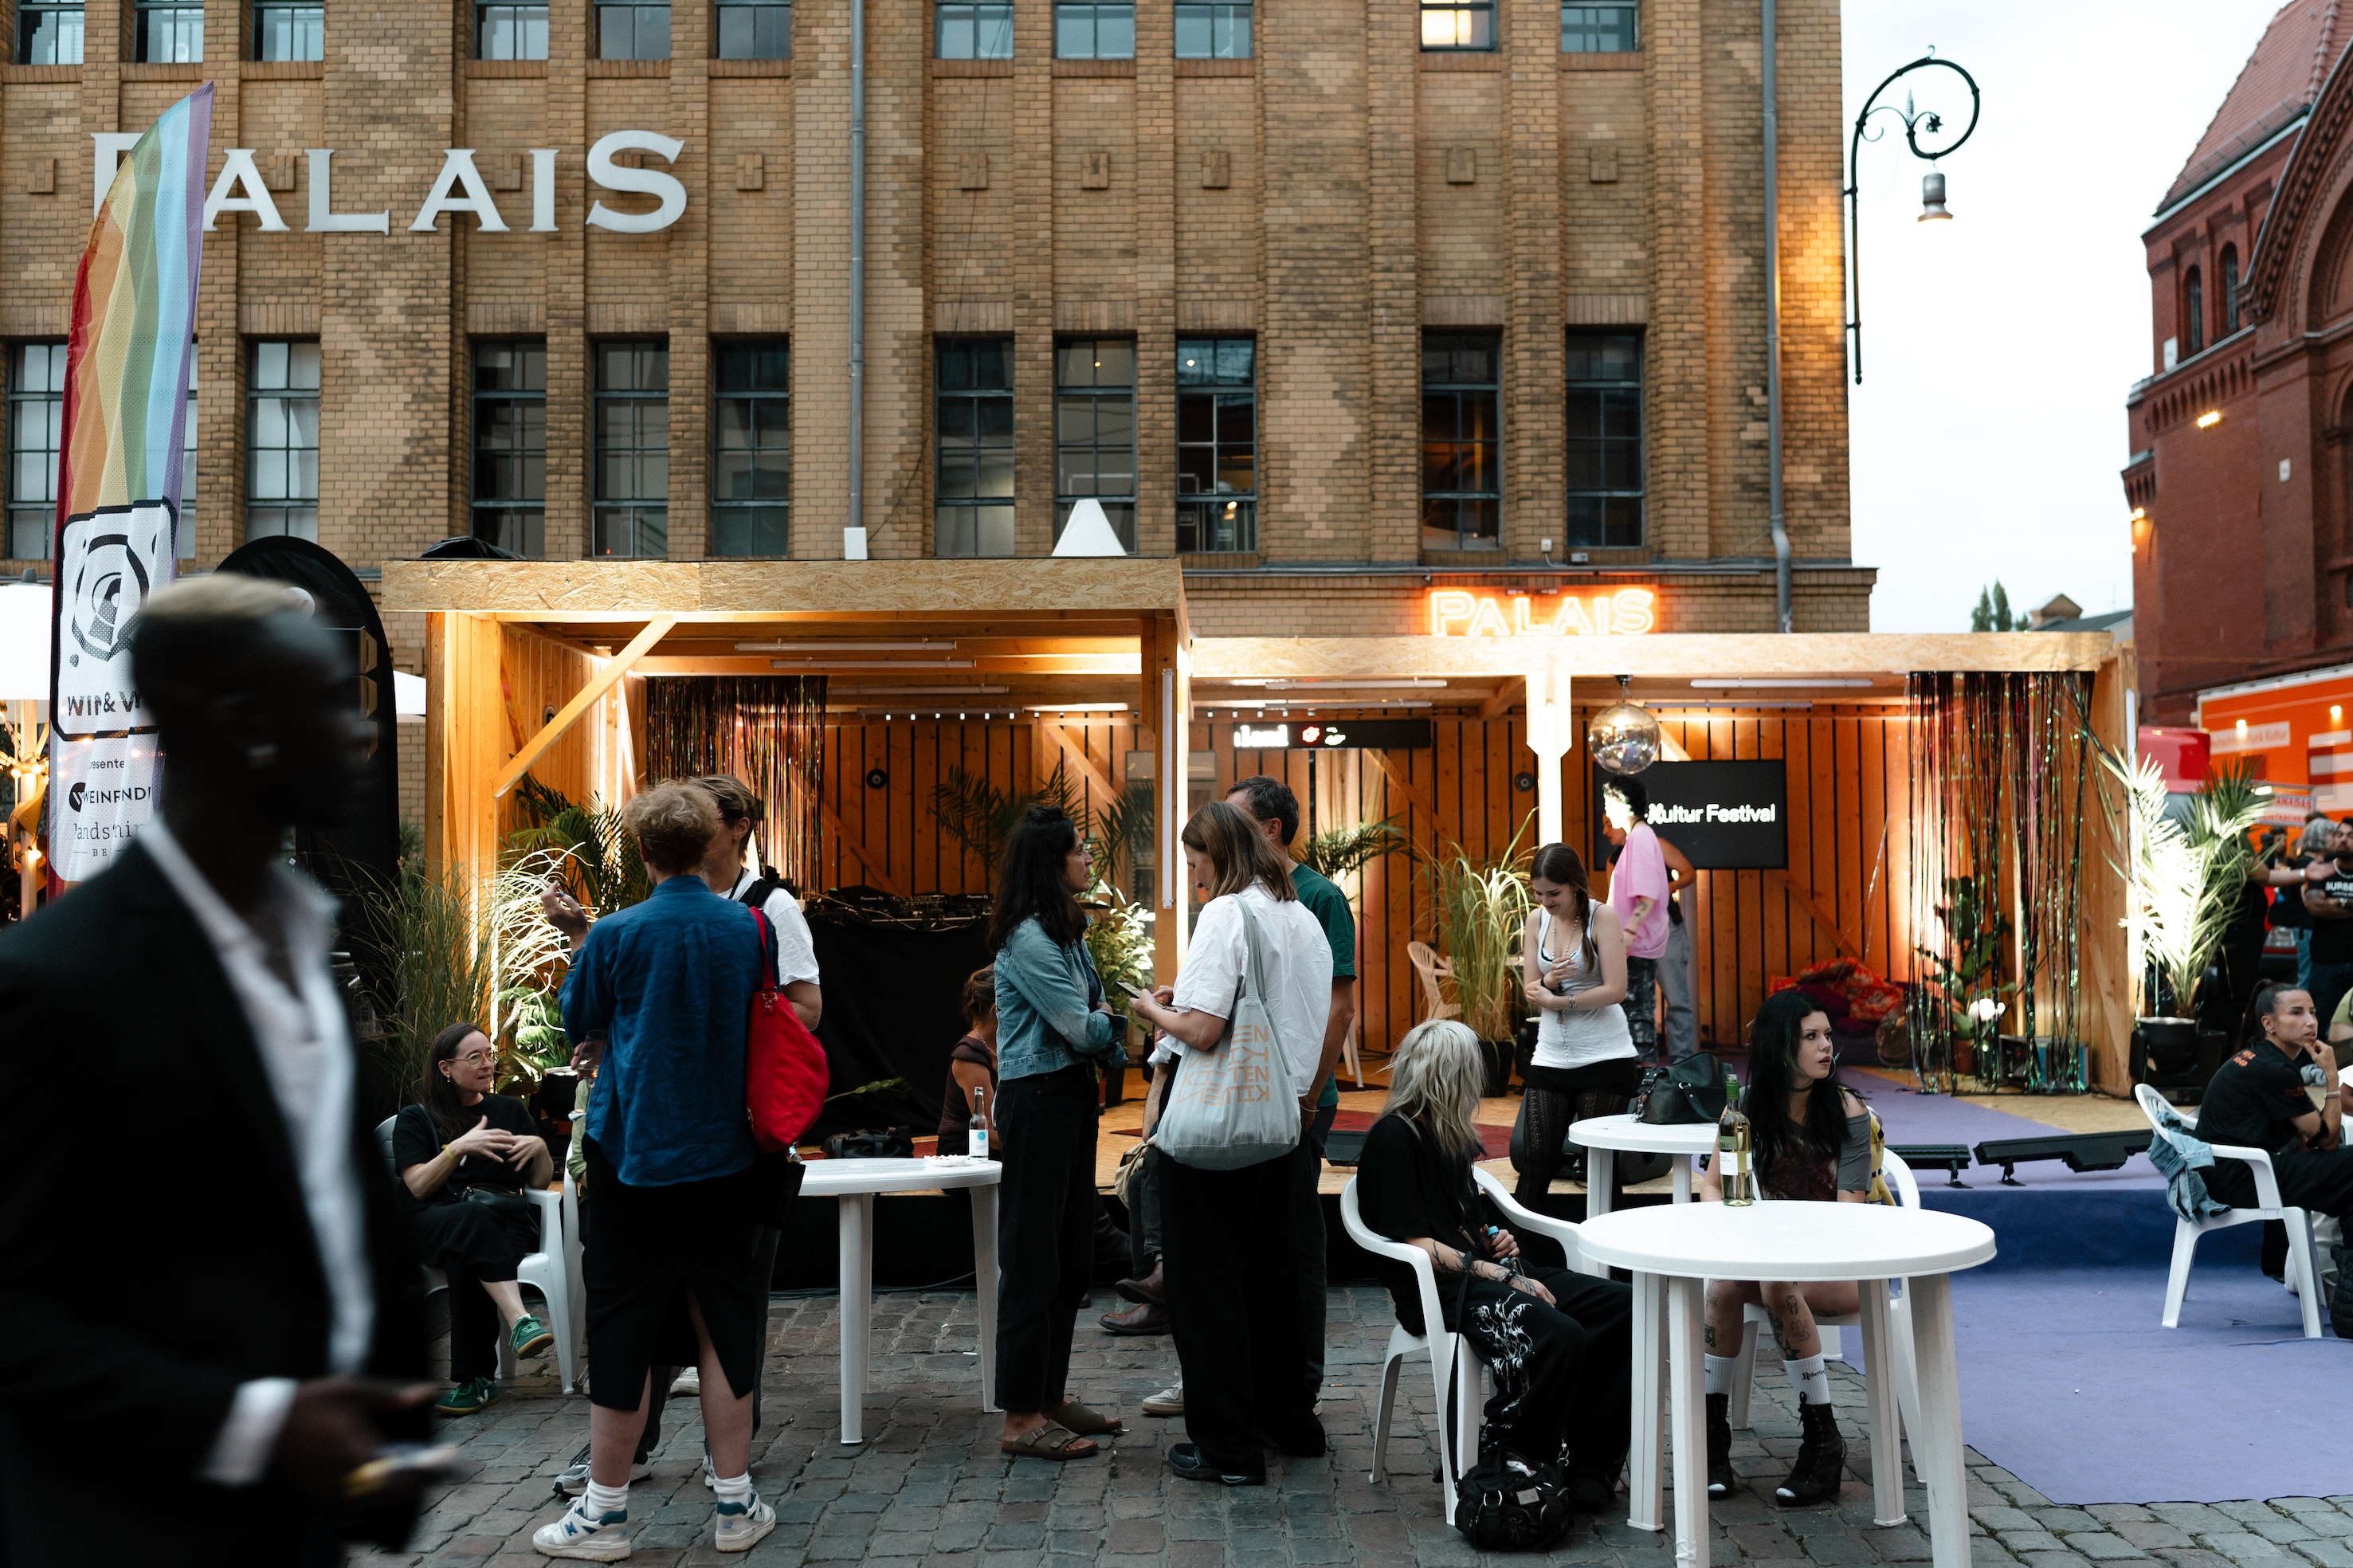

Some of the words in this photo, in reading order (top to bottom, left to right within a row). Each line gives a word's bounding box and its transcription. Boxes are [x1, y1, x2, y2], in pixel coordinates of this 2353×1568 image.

[1431, 589, 1654, 637] PALAIS
[1706, 803, 1776, 823] Festival
[2276, 798, 2312, 812] ANADAS
